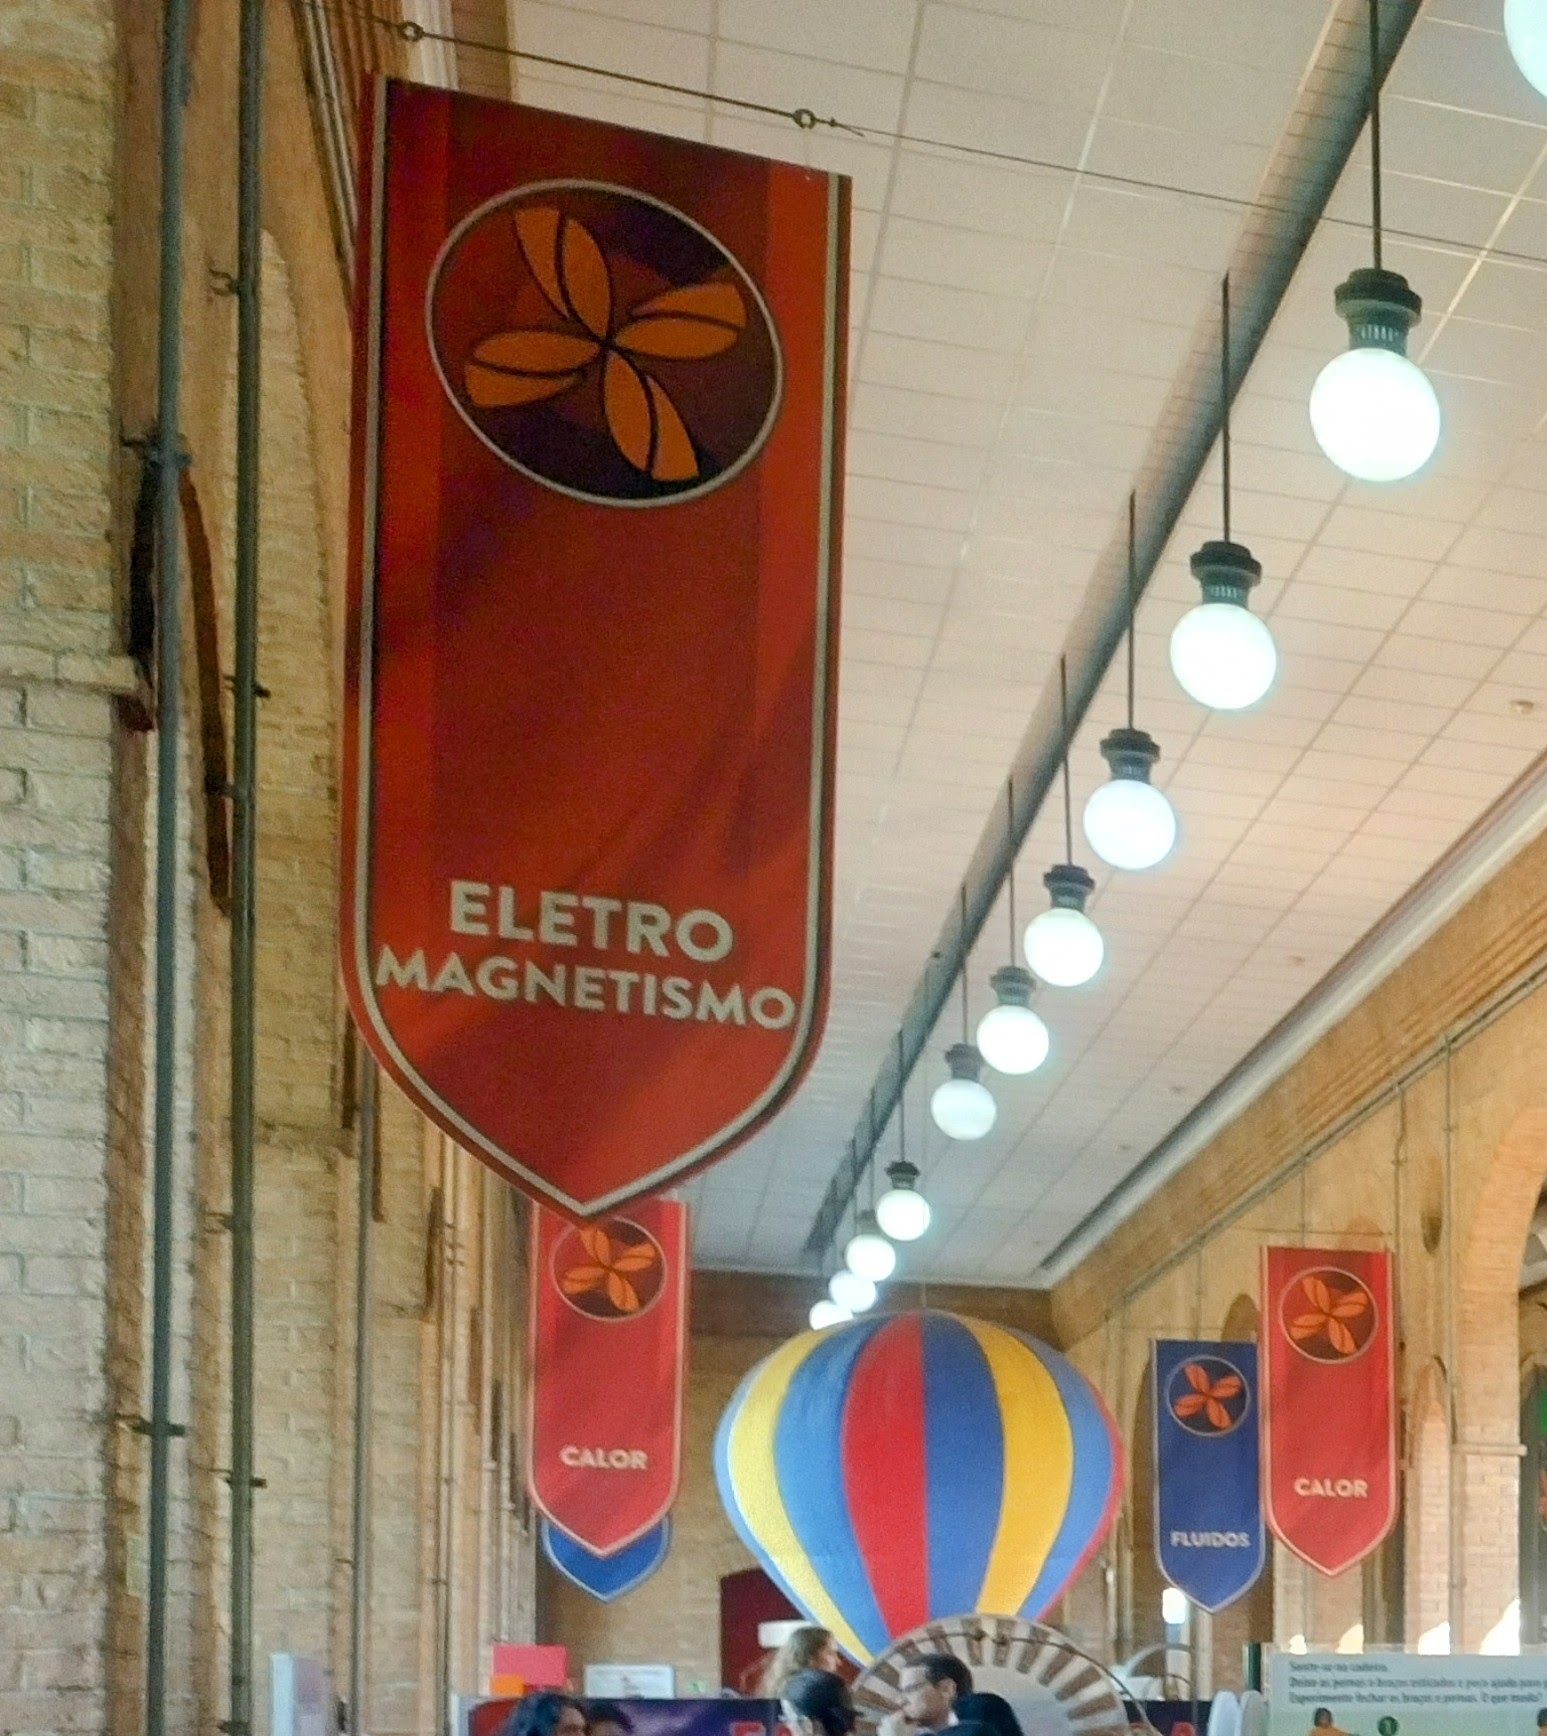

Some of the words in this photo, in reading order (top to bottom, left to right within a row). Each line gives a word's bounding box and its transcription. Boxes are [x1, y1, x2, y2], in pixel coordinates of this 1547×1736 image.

[450, 879, 735, 963] ELETRO
[375, 944, 797, 1031] MAGNETISMO
[559, 1445, 649, 1470] CALOR
[1293, 1478, 1368, 1498] CALOR
[1170, 1531, 1251, 1548] FLUIDOS
